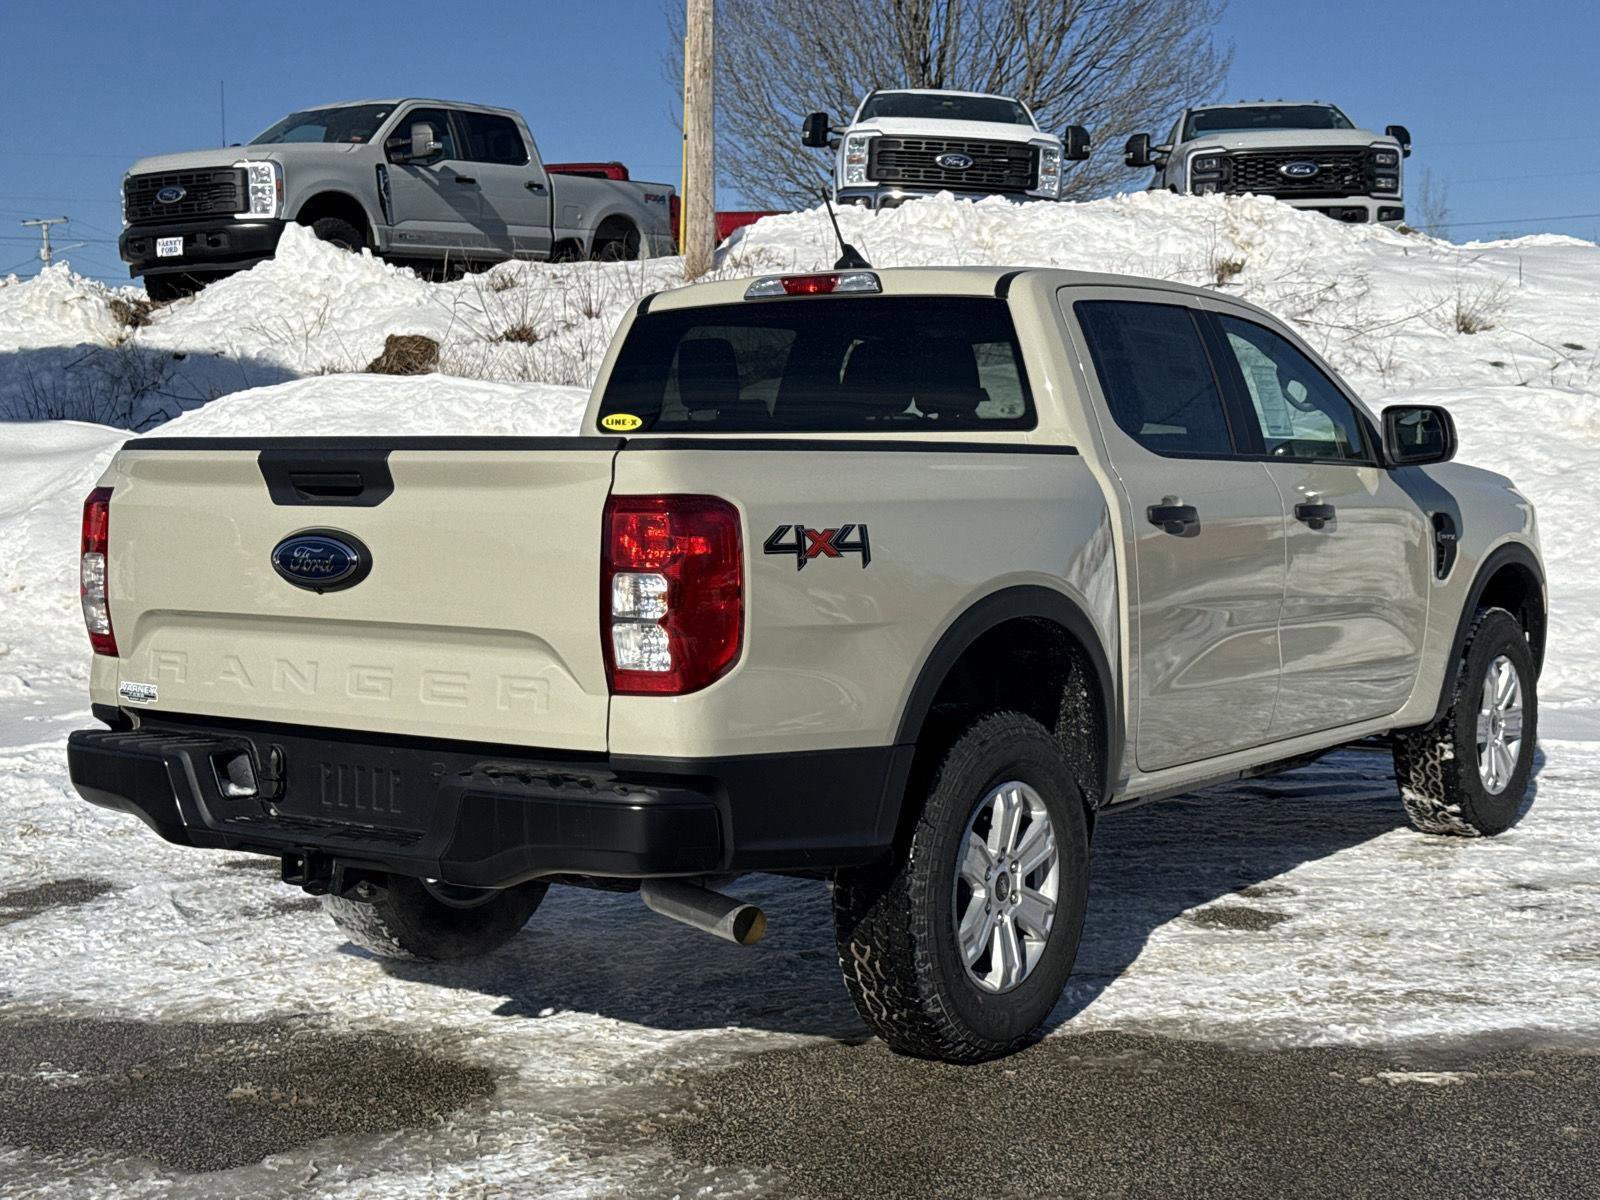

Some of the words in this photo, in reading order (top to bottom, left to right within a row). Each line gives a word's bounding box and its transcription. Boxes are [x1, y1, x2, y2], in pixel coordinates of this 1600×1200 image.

[944, 156, 965, 167] Ford
[158, 239, 182, 247] VARNEY
[161, 246, 178, 254] FORD
[605, 418, 637, 426] LINE-X
[289, 546, 335, 573] Ford
[147, 648, 551, 712] RANGER
[121, 682, 156, 695] VARNEY
